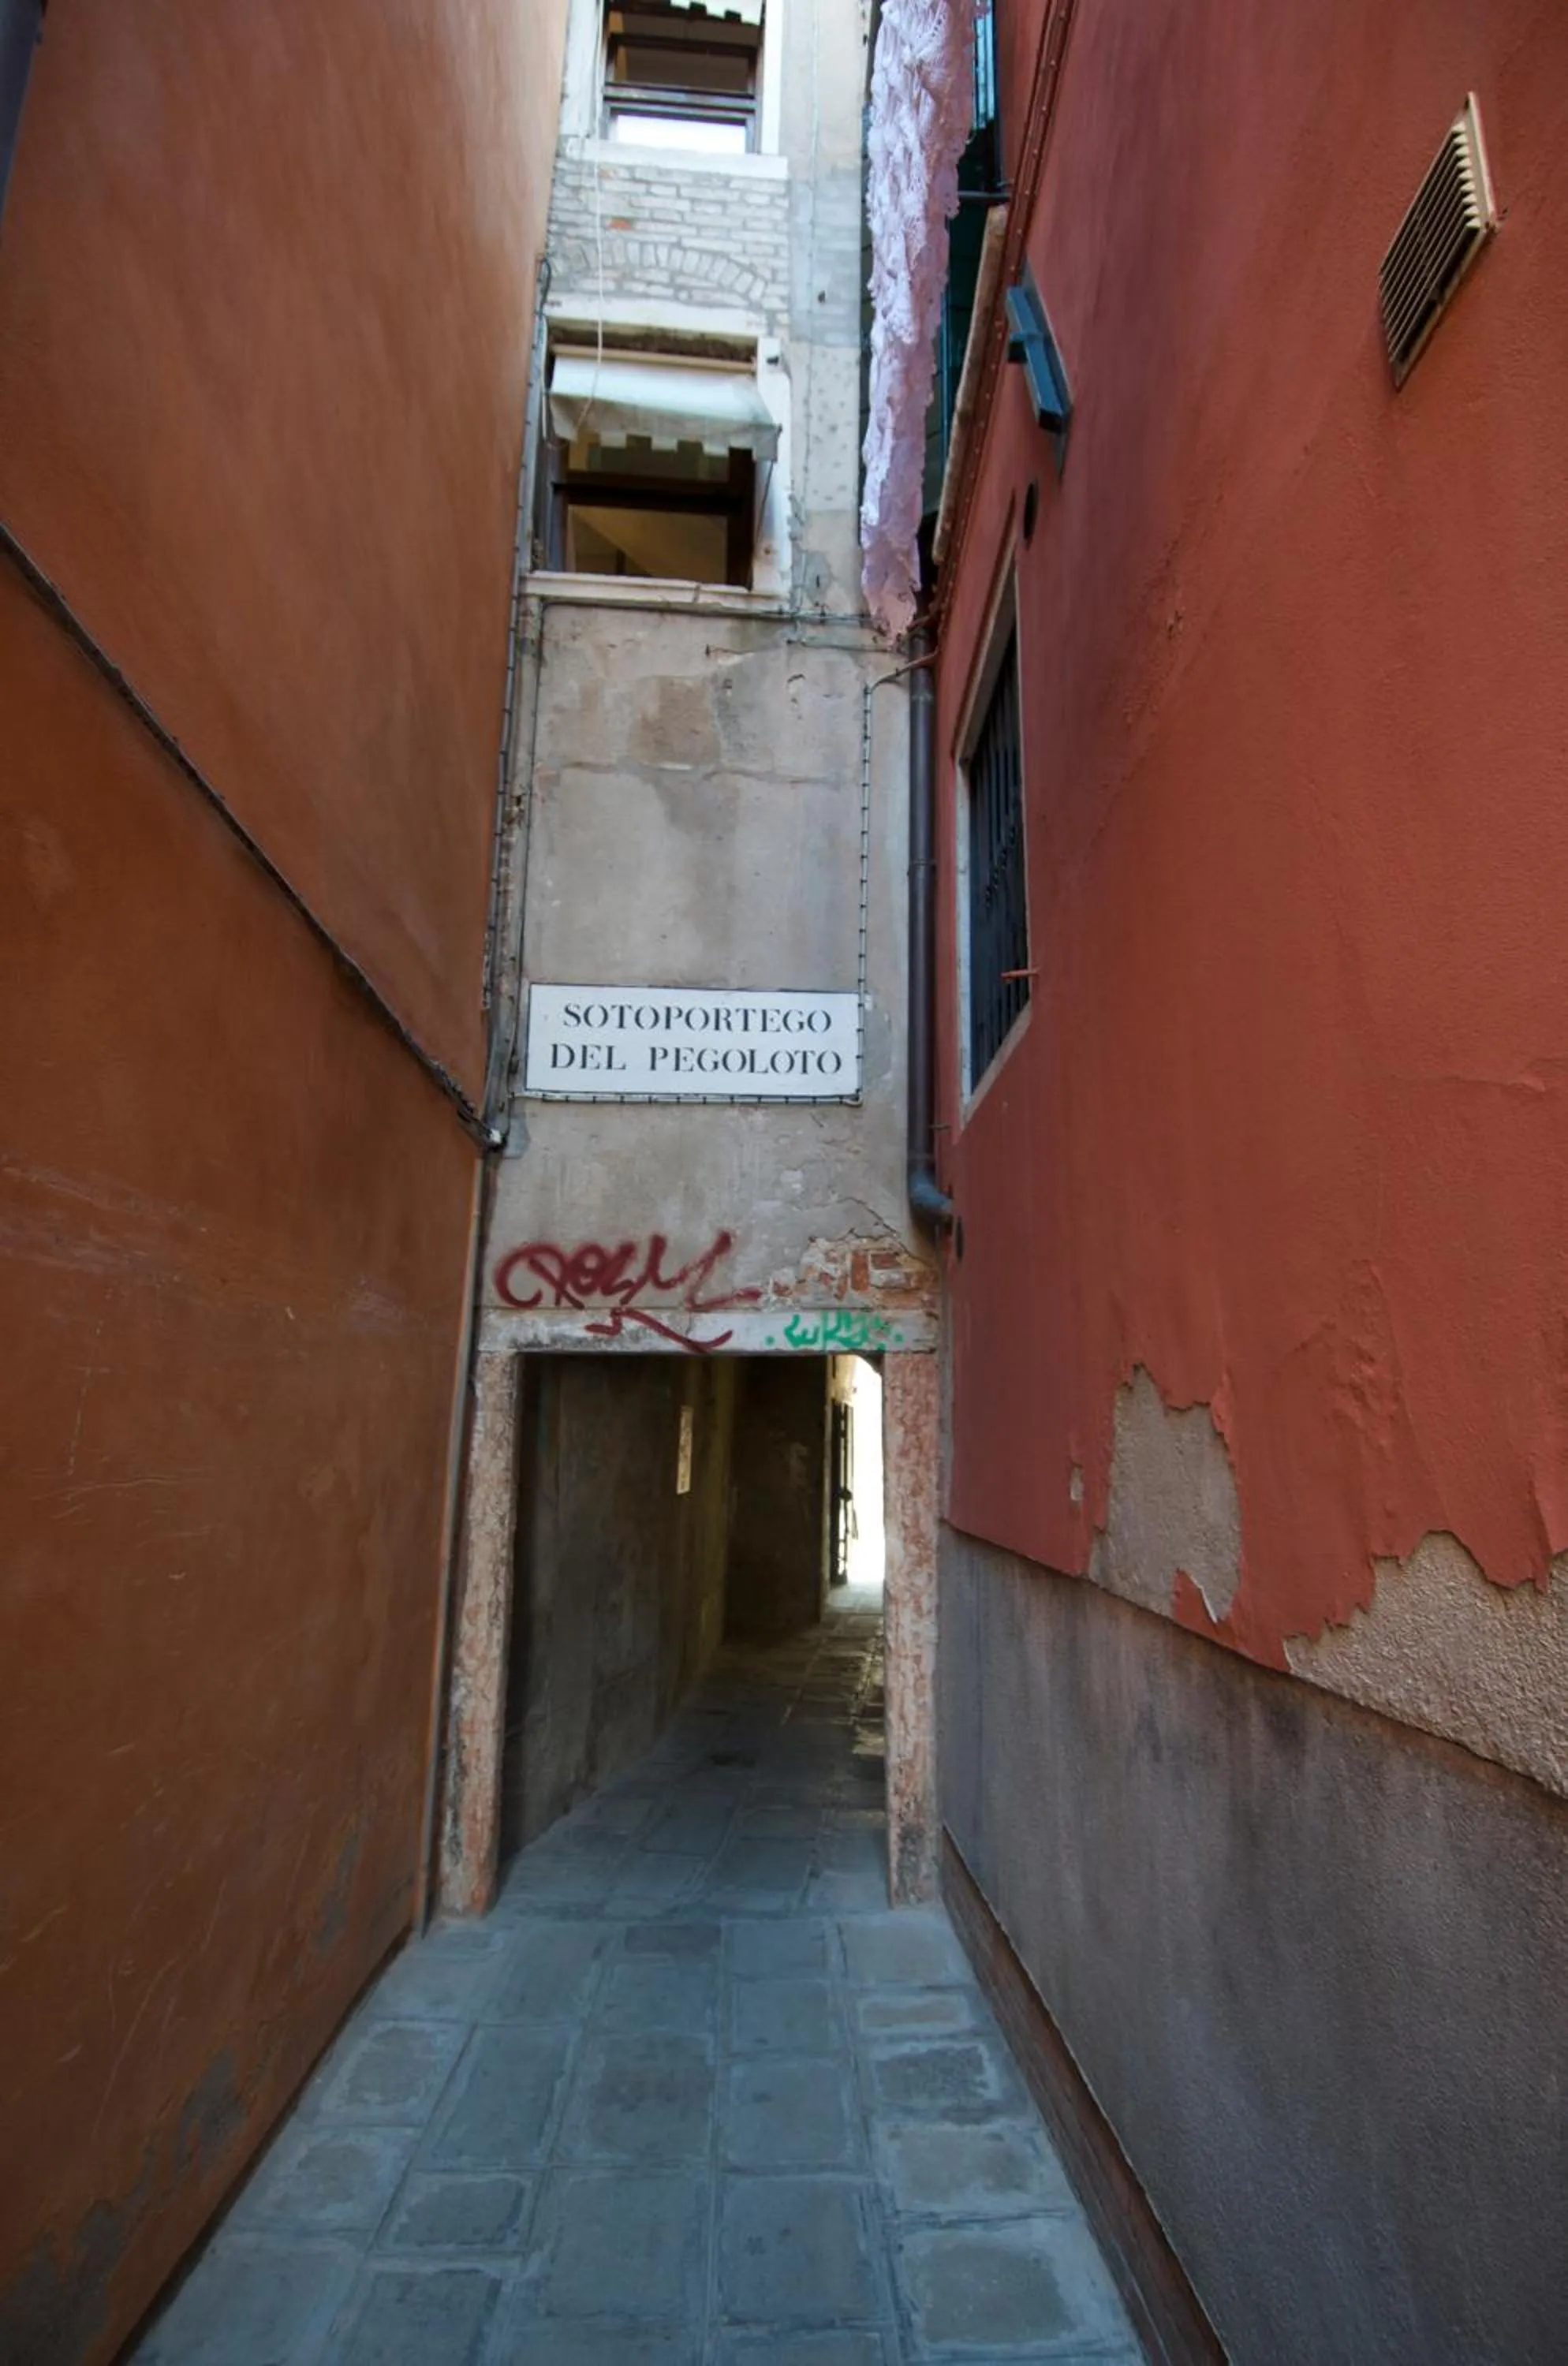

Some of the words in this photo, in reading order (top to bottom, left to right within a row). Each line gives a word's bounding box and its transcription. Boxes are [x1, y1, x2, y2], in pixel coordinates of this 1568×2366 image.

[562, 1003, 832, 1033] SOTOPORTEGO
[551, 1043, 627, 1070] DEL
[648, 1047, 842, 1075] PEGOLOTO
